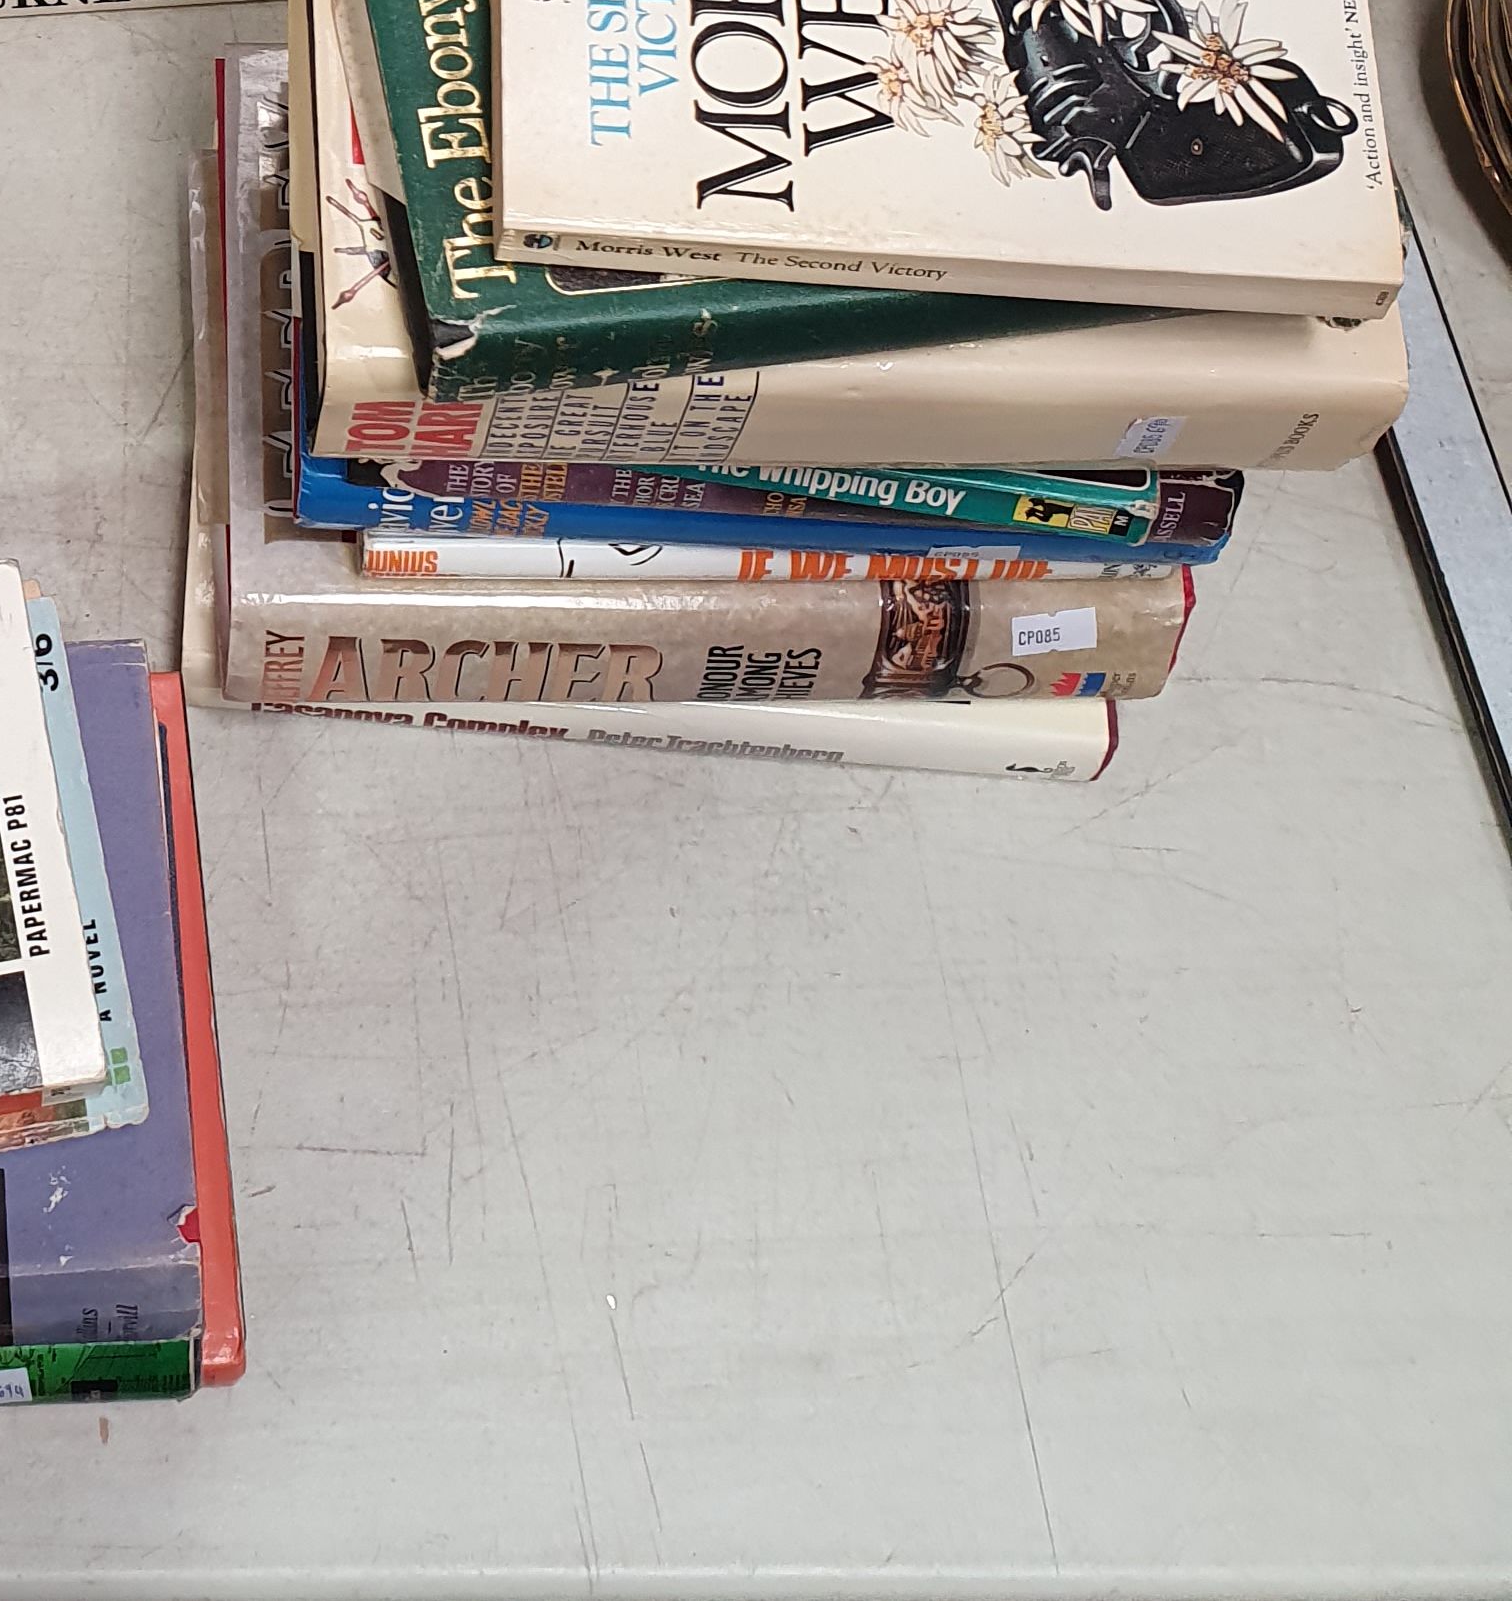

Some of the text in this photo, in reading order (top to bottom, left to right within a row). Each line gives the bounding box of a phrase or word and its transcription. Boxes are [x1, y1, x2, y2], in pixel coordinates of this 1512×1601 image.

[587, 42, 631, 147] THE
[1354, 92, 1374, 123] and
[443, 175, 516, 299] The
[575, 239, 948, 281] Morris West The Second Victory
[344, 400, 416, 452] TOM
[679, 374, 725, 437] ON THE
[639, 421, 678, 452] BLUE
[496, 473, 517, 494] OF
[680, 482, 706, 508] SEA
[756, 465, 898, 507] Whipping
[904, 478, 968, 517] Boy
[366, 549, 439, 575] JUNIUS
[1017, 627, 1061, 647] CP085
[34, 632, 61, 692] 3/6
[310, 636, 664, 703] ARCHER
[423, 711, 569, 740] Complex
[3, 792, 51, 959] PAPERMAC P81
